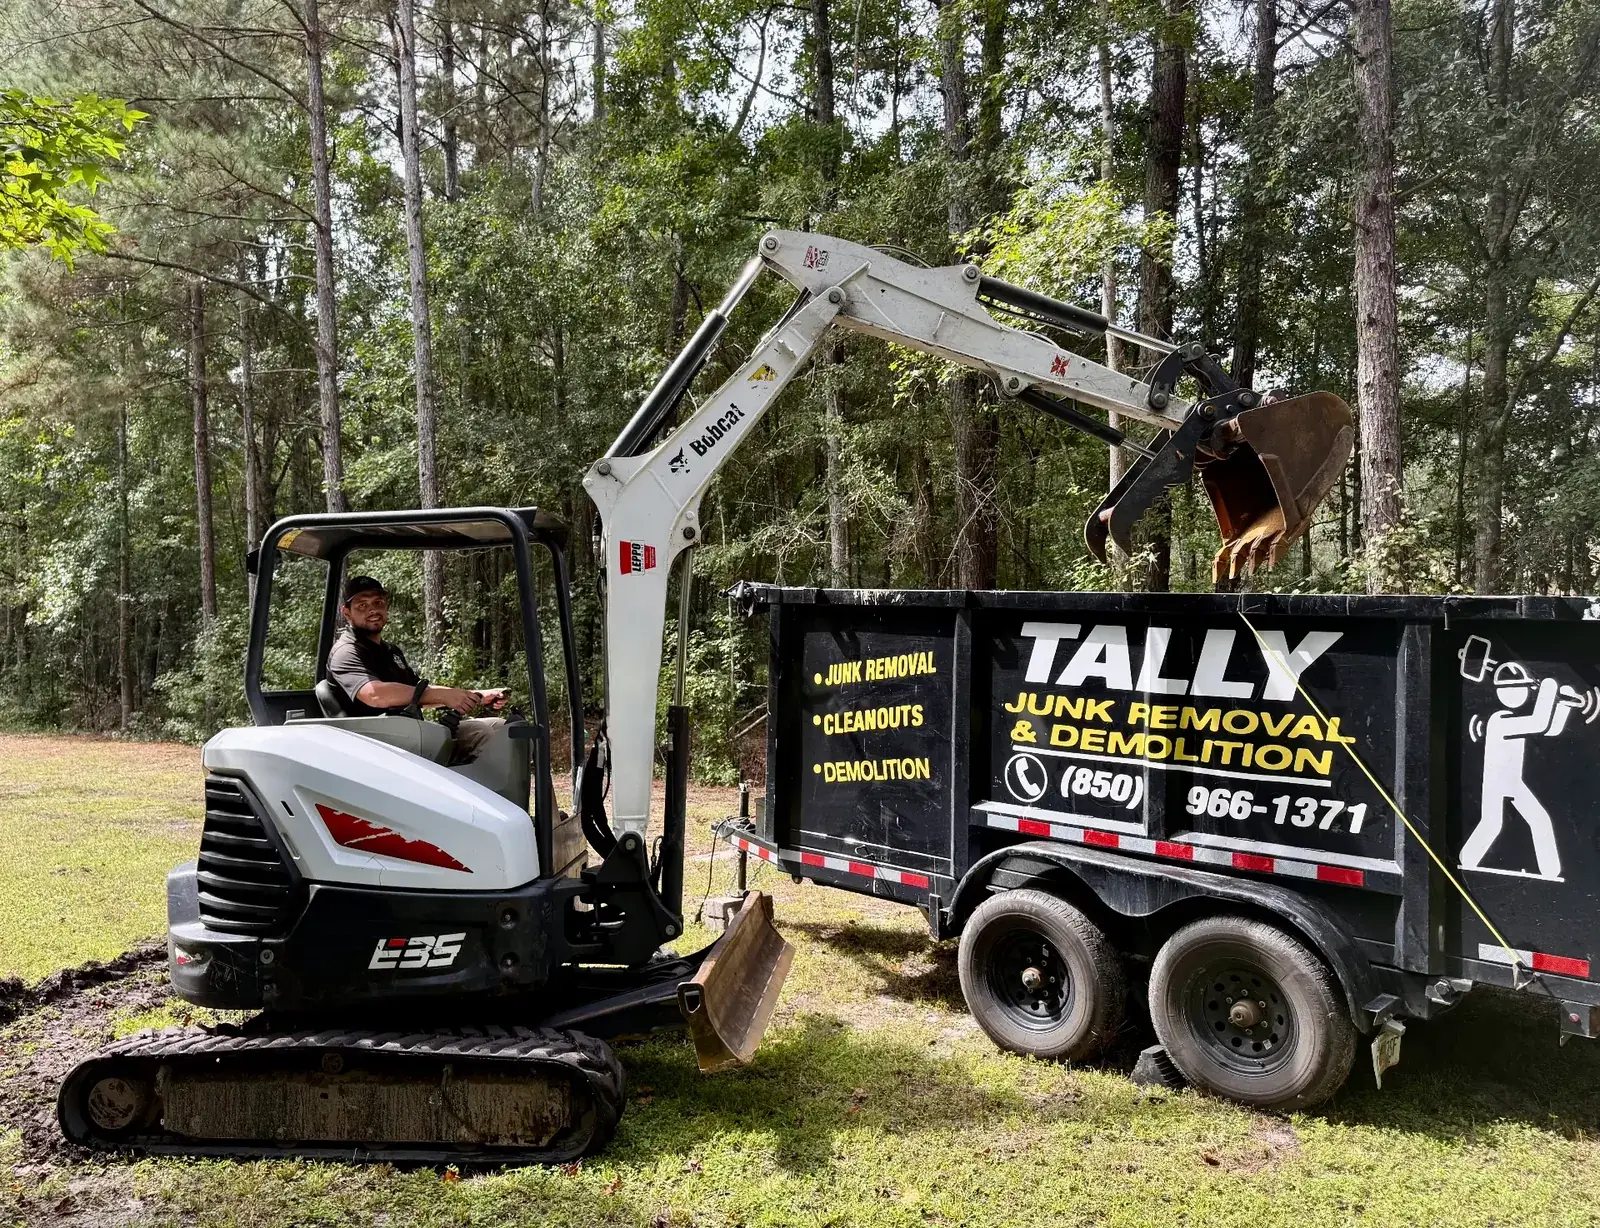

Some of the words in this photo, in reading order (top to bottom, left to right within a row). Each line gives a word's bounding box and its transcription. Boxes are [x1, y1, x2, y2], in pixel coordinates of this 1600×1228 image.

[689, 403, 745, 457] Bobcat
[631, 543, 641, 572] LEPPO
[825, 661, 862, 685] JUNK
[865, 651, 936, 681] REMOVAL
[1020, 621, 1344, 702] TALLY
[823, 704, 924, 735] CLEANOUTS
[1005, 692, 1116, 723] JUNK
[1127, 702, 1356, 744] REMOVAL
[823, 757, 931, 783] DEMOLITION
[1010, 720, 1037, 743] &
[1050, 724, 1334, 776] DEMOLITION
[1060, 765, 1144, 810] (850)
[1186, 786, 1368, 834] 966-1371
[368, 932, 467, 970] E35
